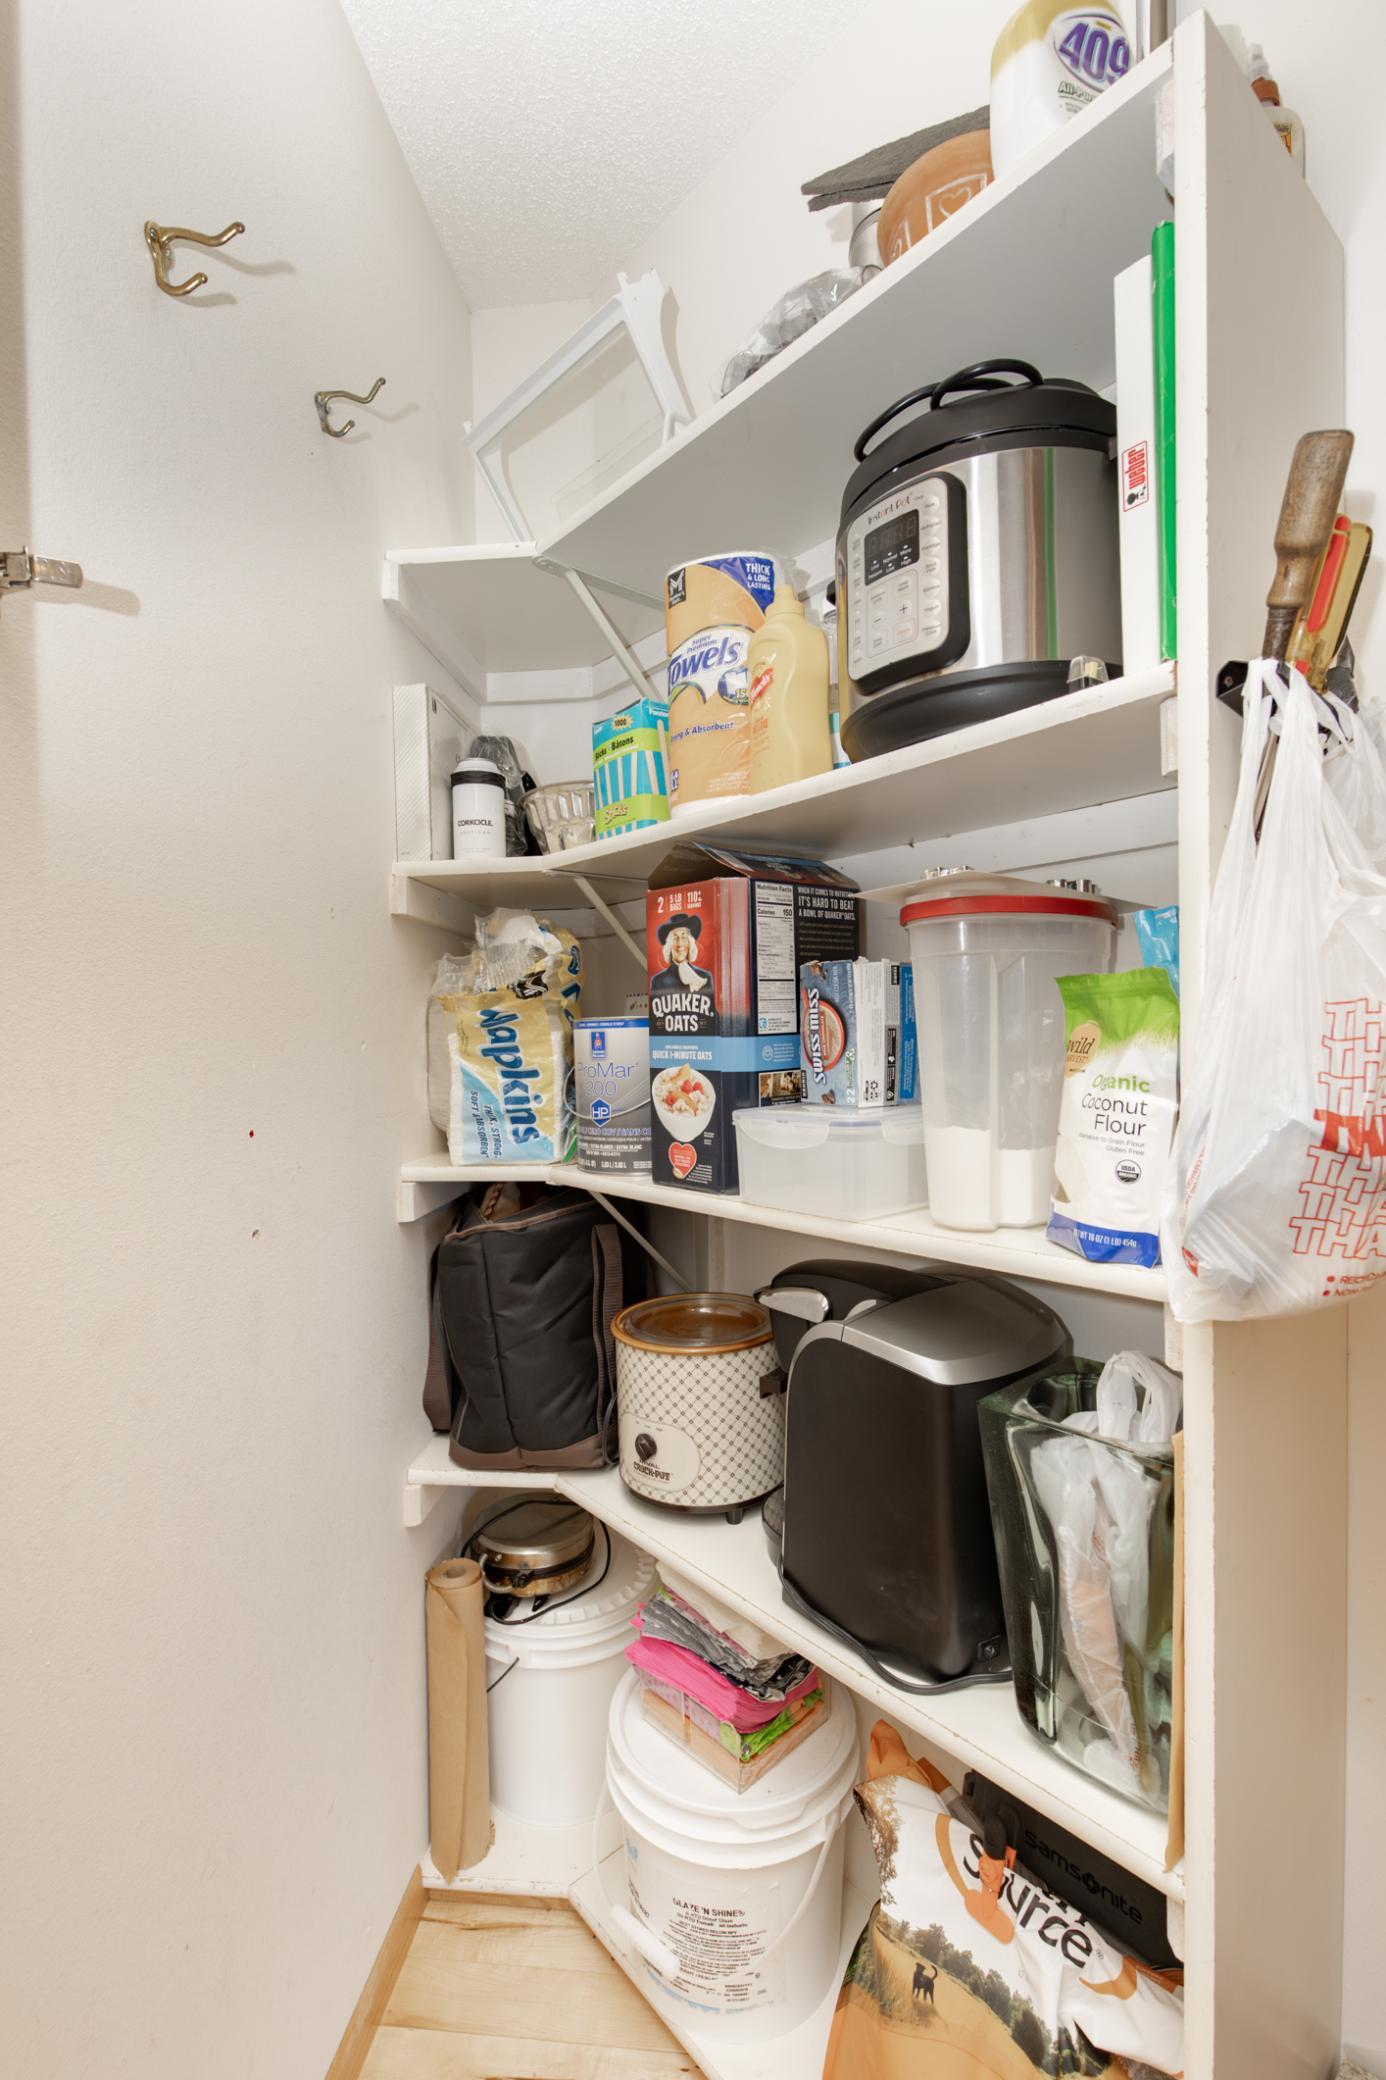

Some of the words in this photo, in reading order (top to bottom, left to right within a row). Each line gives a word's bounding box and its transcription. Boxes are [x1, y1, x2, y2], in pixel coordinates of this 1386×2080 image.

[1059, 23, 1130, 85] 409
[1058, 80, 1096, 102] All-Pur
[1125, 448, 1145, 490] weber
[745, 563, 771, 575] THICK
[692, 722, 734, 734] Absorbent
[657, 896, 664, 913] 2
[783, 908, 792, 916] 150
[798, 896, 810, 906] IT'S
[812, 897, 829, 908] HARD
[831, 899, 838, 909] TO
[840, 900, 854, 910] BEAT
[803, 909, 817, 918] BOWL
[652, 993, 712, 1017] QUAKER
[808, 988, 820, 1030] MISS
[665, 1014, 699, 1032] OATS
[811, 1033, 826, 1085] SWISS
[479, 1008, 544, 1145] Napkins
[577, 1062, 635, 1079] ProMar
[585, 1080, 617, 1097] 200
[1092, 1074, 1151, 1093] Oganic
[470, 1089, 480, 1111] SOFT
[846, 1088, 855, 1104] 22
[1081, 1092, 1149, 1116] Coconut
[593, 1106, 609, 1119] HP
[1094, 1113, 1147, 1136] Flour
[474, 1116, 488, 1159] ABSORBEN
[1128, 1148, 1145, 1156] Free
[633, 1461, 671, 1481] CROCK-POT
[672, 1897, 700, 1912] GLAZE
